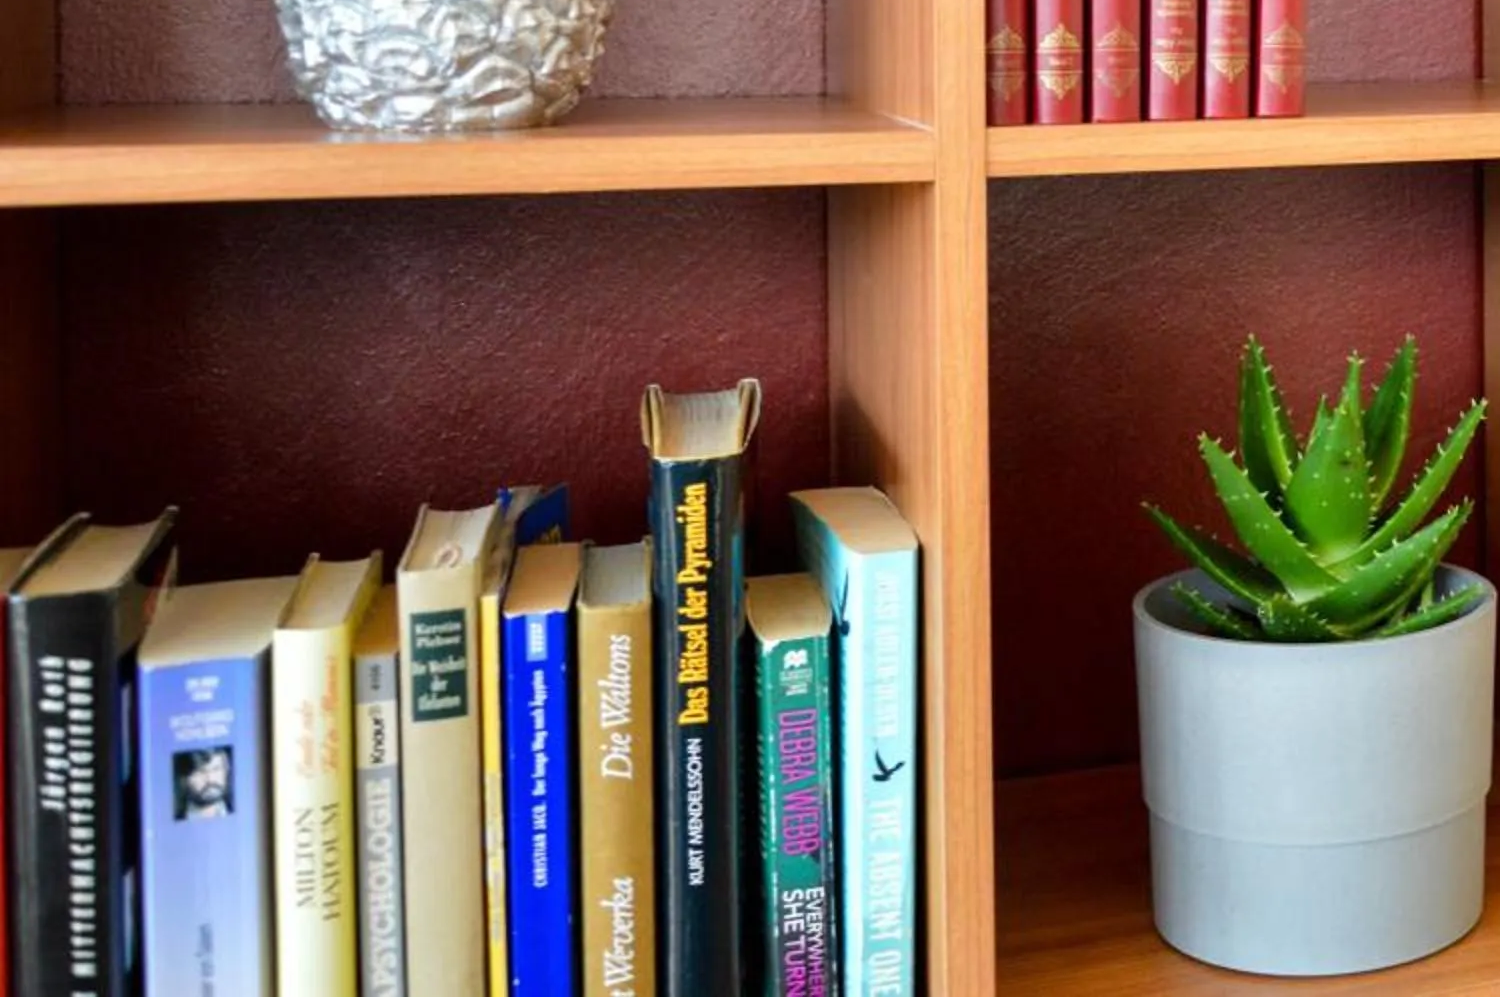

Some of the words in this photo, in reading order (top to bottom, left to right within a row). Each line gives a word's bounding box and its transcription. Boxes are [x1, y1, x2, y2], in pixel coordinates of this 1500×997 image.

[676, 482, 711, 584] Pyramiden
[677, 587, 707, 619] der
[597, 633, 634, 728] Waltons
[677, 624, 708, 683] Rätsel
[37, 655, 65, 713] Roth
[677, 687, 709, 725] Das
[38, 726, 71, 811] Jürgen
[369, 715, 386, 765] Knaur
[599, 732, 634, 780] Die
[778, 707, 819, 785] DEBRA
[686, 738, 703, 845] MENDELSSOHN
[867, 797, 905, 842] THE
[781, 786, 821, 857] WEBB
[294, 806, 318, 909] MILTON
[320, 801, 342, 922] HATOUM
[531, 832, 549, 888] CHRISTIAN
[687, 847, 704, 886] KURT
[781, 889, 805, 934] SHE
[867, 851, 905, 942] ABSENT
[804, 885, 826, 997] EVERYWHER
[867, 948, 904, 997] ONE
